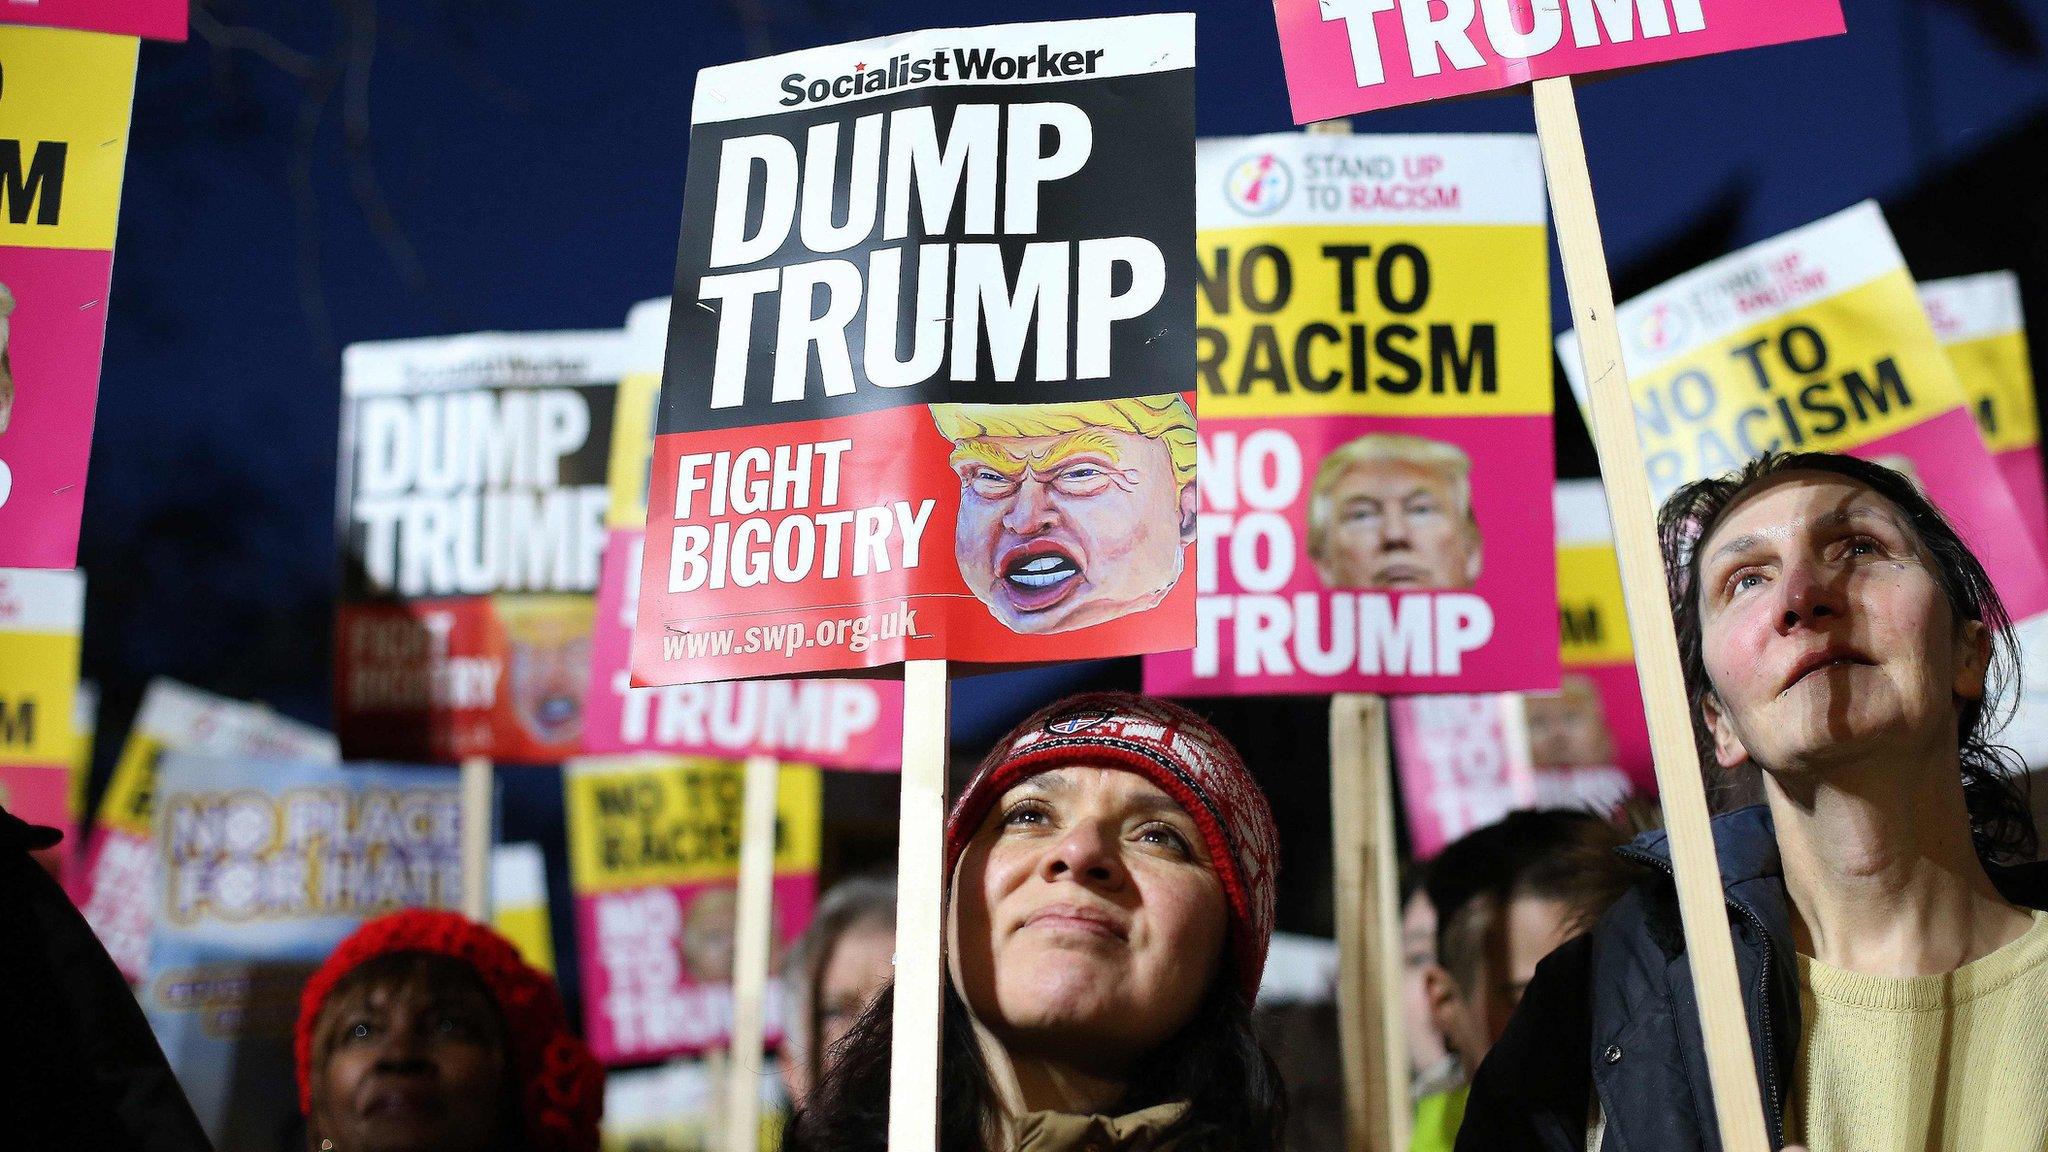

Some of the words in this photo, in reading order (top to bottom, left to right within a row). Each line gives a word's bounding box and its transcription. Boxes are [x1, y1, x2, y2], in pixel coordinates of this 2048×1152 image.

[778, 49, 951, 107] Socialist
[953, 44, 1104, 81] Worker
[709, 101, 1093, 269] DUMP
[1304, 154, 1396, 180] STAND
[1403, 154, 1445, 180] UP
[1304, 185, 1343, 211] TO
[1350, 184, 1462, 211] RACISM
[1196, 243, 1294, 316] NO
[1321, 241, 1431, 315] TO
[698, 236, 1167, 410] TRUMP
[1196, 321, 1497, 396] RACISM
[1730, 324, 1829, 392] TO
[360, 387, 592, 494] DUMP
[673, 438, 853, 521] FIGHT
[1197, 429, 1303, 513] NO
[667, 499, 937, 594] BIGOTRY
[1197, 511, 1296, 594] TO
[662, 602, 919, 662] www.swp.org.uk
[1192, 590, 1496, 679] TRUMP
[611, 673, 881, 753] TRUMP
